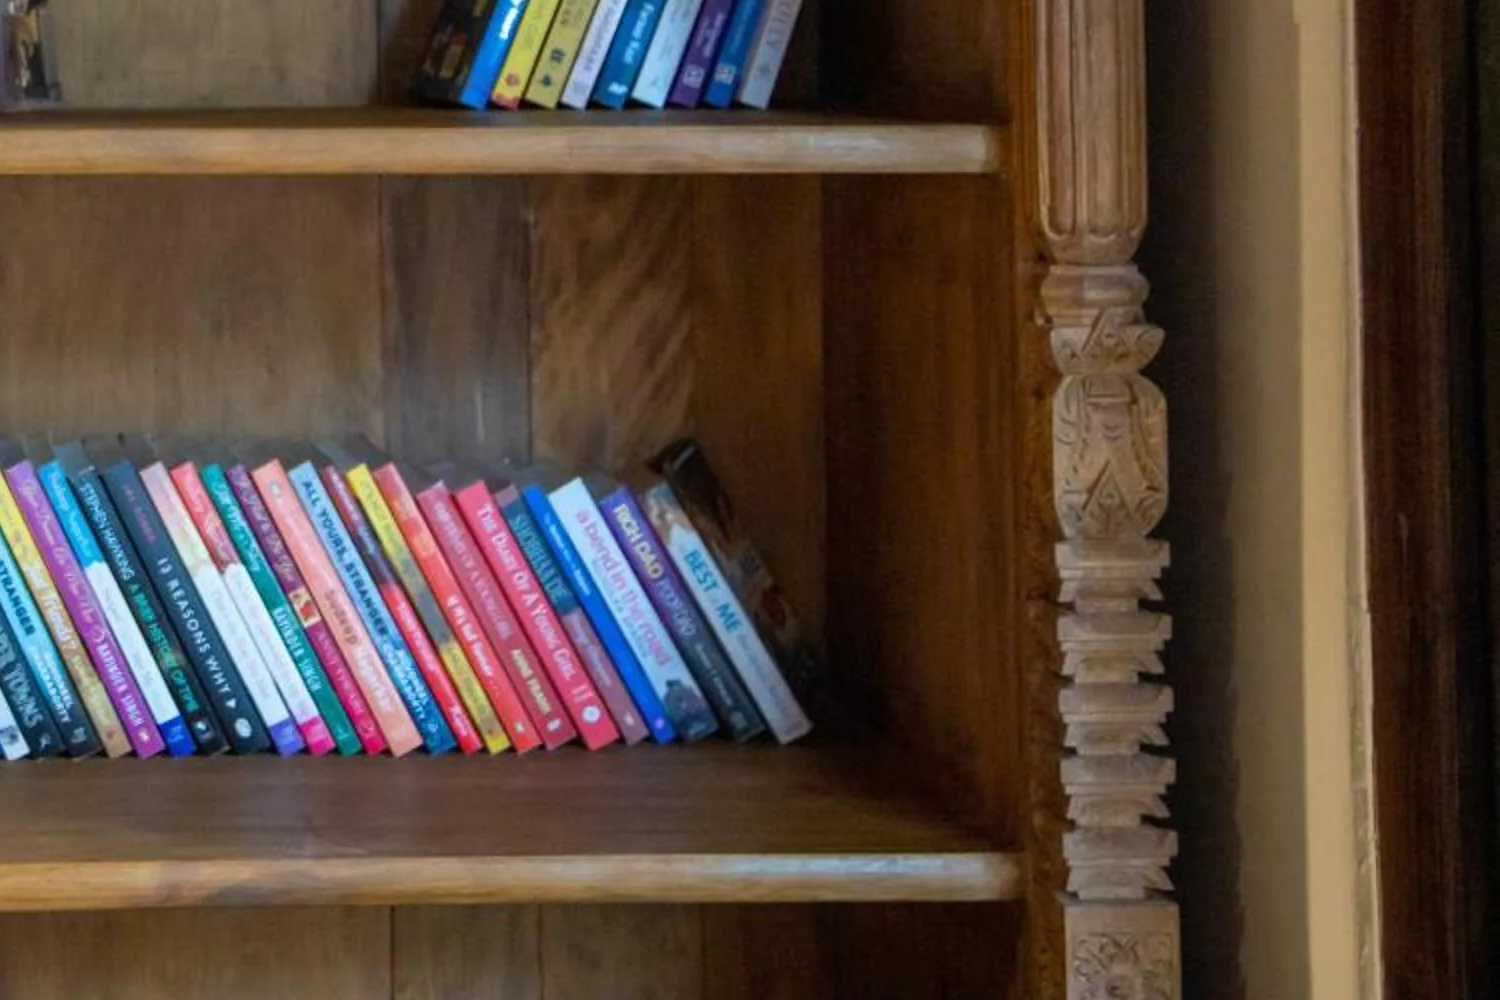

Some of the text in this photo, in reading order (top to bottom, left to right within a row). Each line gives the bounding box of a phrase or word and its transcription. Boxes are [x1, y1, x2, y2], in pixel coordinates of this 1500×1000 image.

[77, 481, 136, 582] STEPHEN HAWKING
[300, 479, 322, 507] ALL
[313, 507, 350, 563] YOURS,
[342, 560, 389, 638] STRANGER
[610, 501, 666, 582] RICH DAD
[154, 555, 232, 695] 13 REASONS WHY
[321, 588, 360, 647] Sudeep
[520, 588, 540, 607] A
[574, 509, 671, 667] a bend in the road
[671, 607, 698, 639] DAD
[682, 548, 743, 635] BEST ME
[128, 581, 140, 594] A
[146, 620, 179, 671] HISTORY
[170, 668, 186, 687] OF
[297, 657, 324, 693] SINGH
[1, 665, 47, 729] TOWNS
